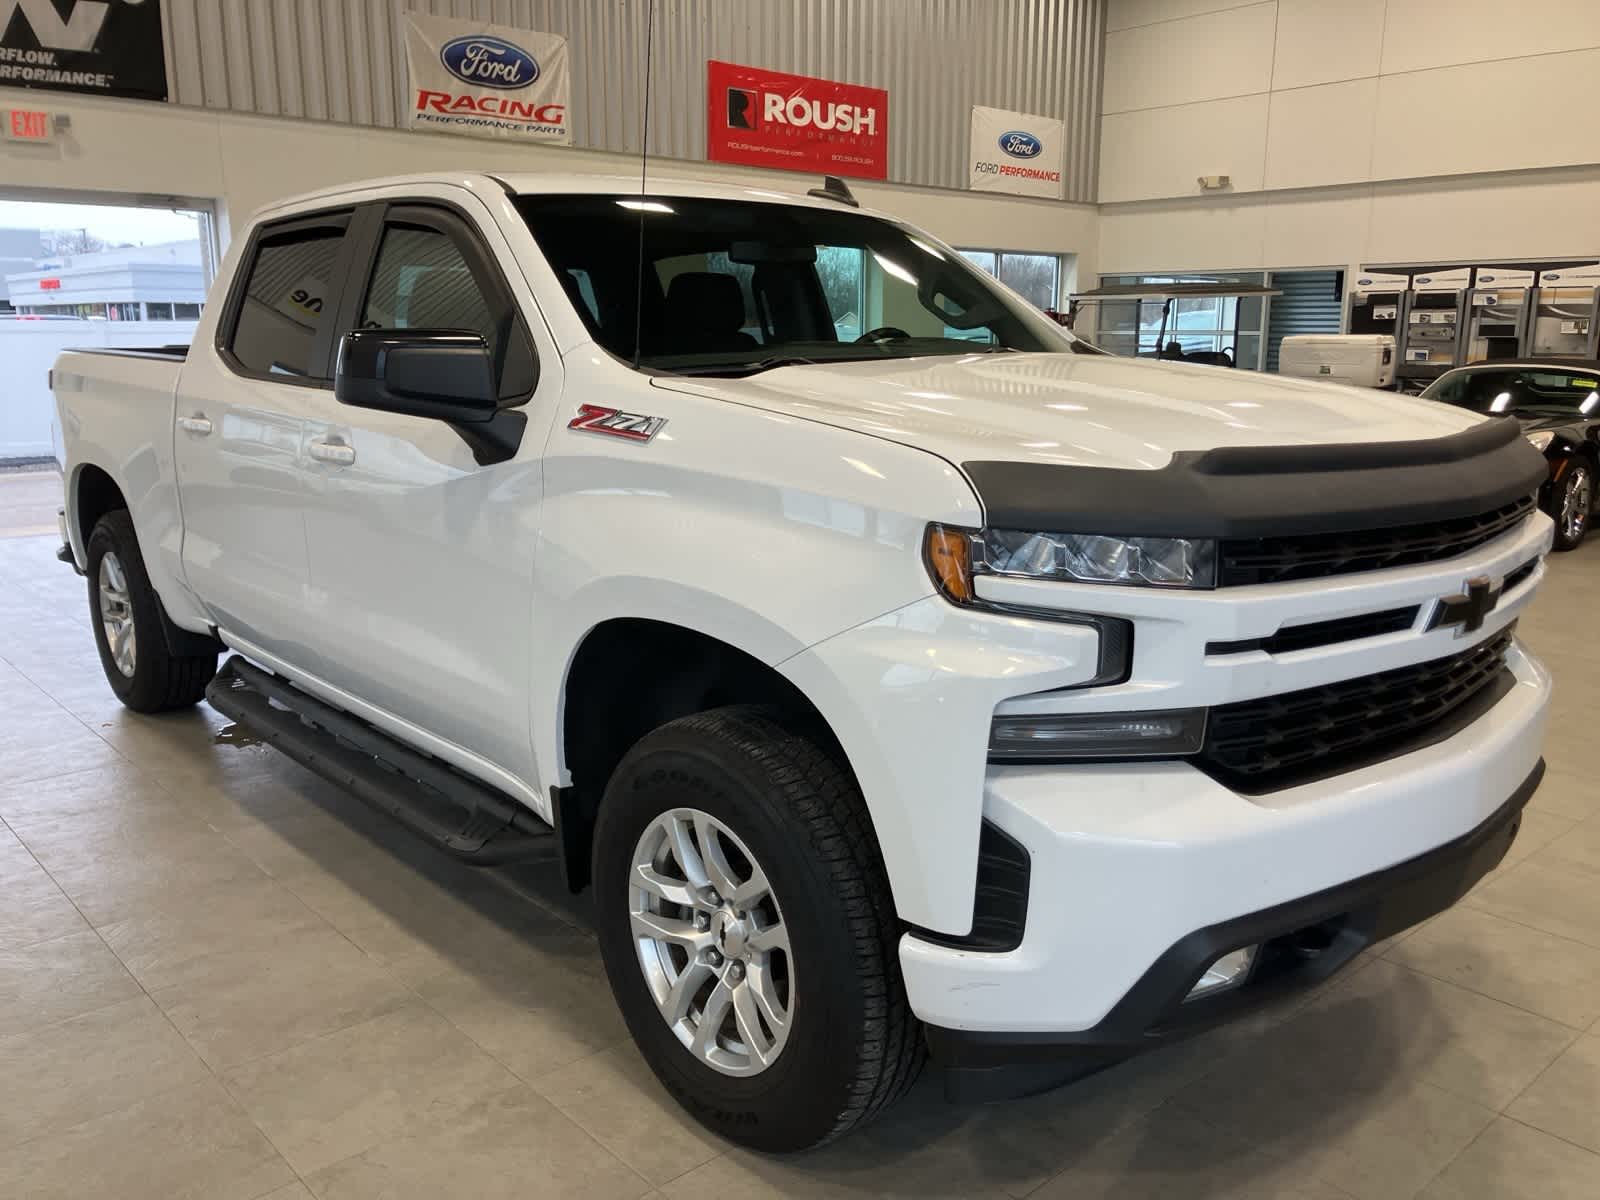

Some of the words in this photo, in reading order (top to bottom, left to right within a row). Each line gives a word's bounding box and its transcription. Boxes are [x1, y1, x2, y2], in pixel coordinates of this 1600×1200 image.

[460, 43, 521, 82] Ford
[416, 90, 565, 124] RACING
[764, 93, 876, 136] ROUSH
[11, 111, 48, 137] EXIT
[416, 113, 522, 131] PERFORMANCE
[526, 125, 566, 135] PARTS
[1007, 135, 1034, 154] Ford
[975, 162, 999, 174] FORD
[1000, 165, 1061, 182] PERFORMANCE
[567, 404, 668, 442] Z71
